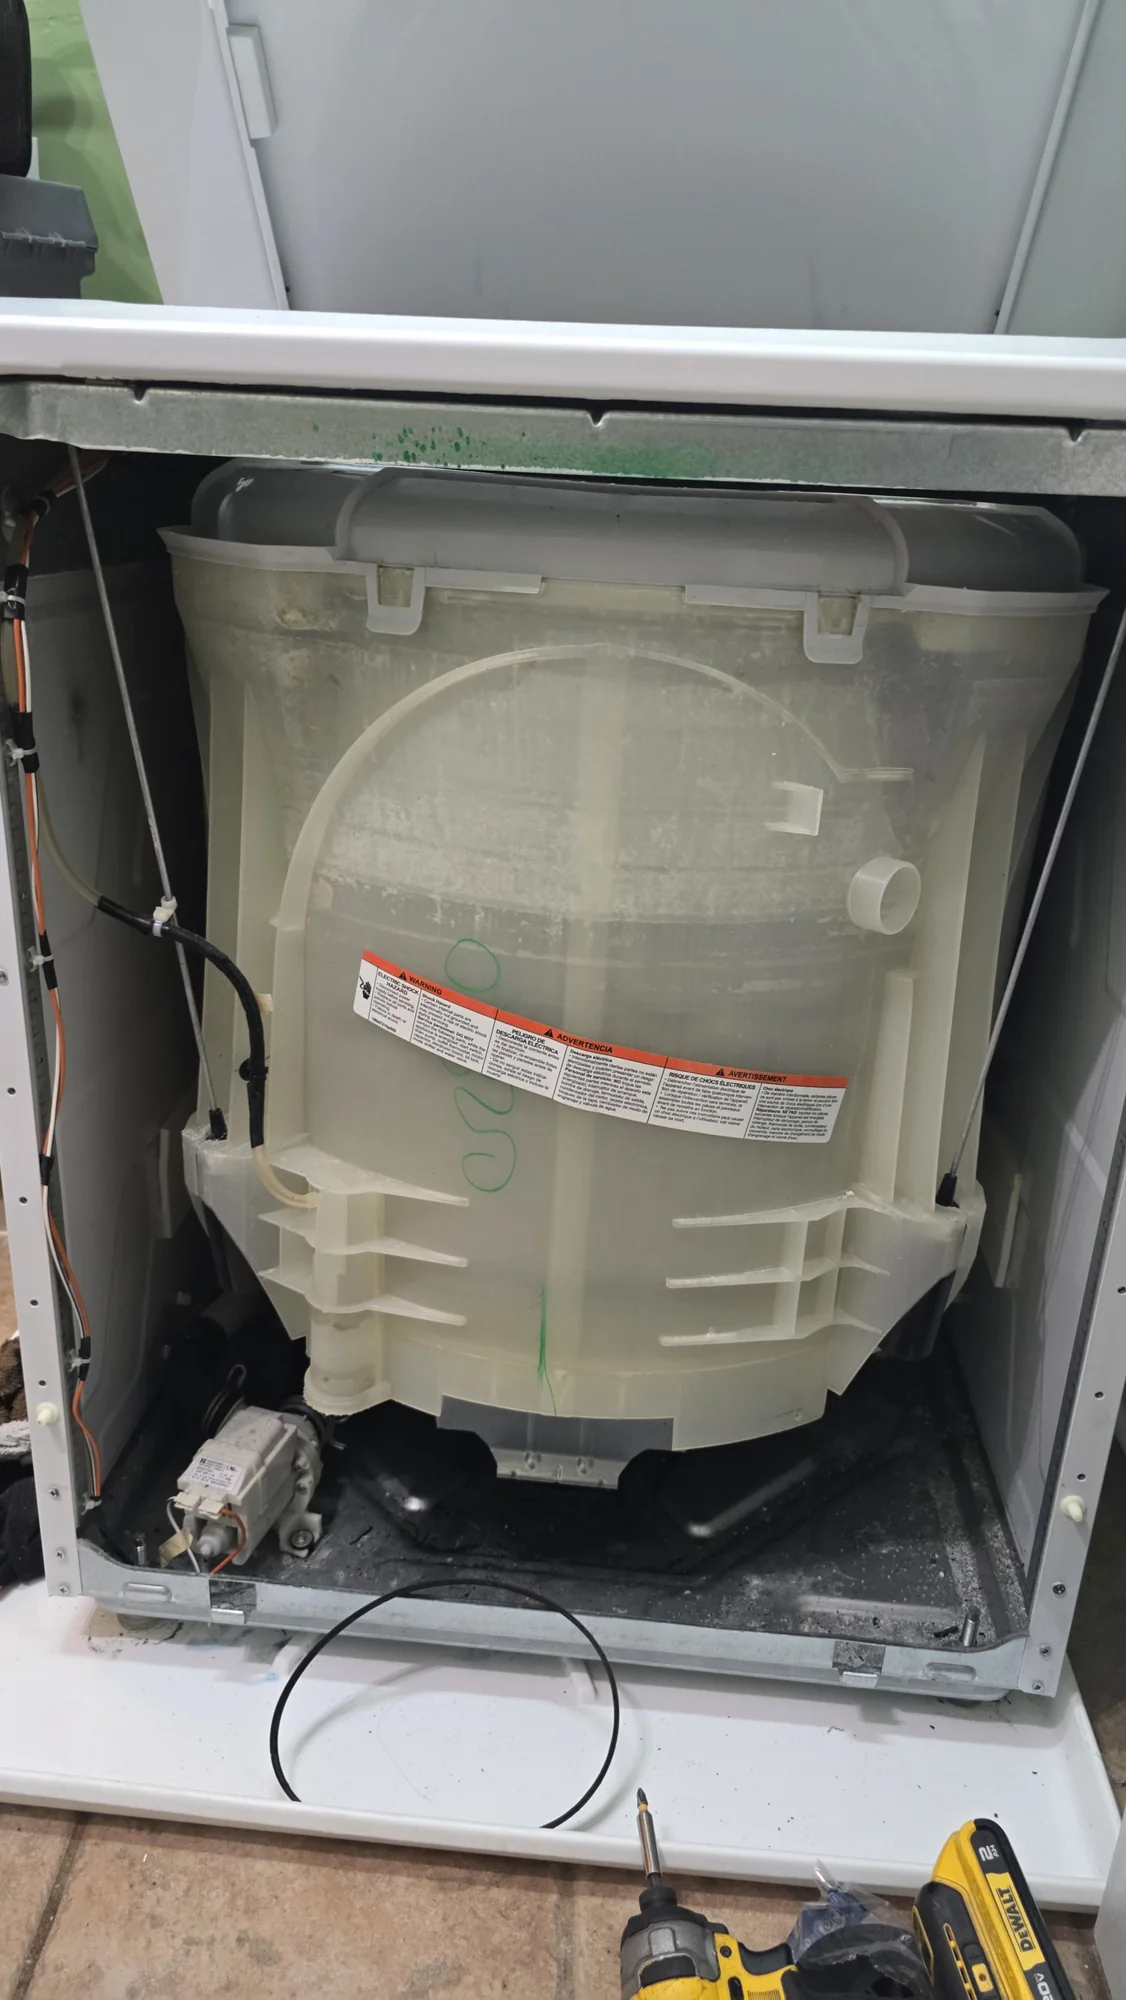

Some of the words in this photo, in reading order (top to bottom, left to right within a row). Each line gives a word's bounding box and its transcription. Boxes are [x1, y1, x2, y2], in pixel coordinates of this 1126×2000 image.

[378, 971, 401, 986] ELECTRIC
[401, 983, 419, 995] SHOCK
[386, 981, 408, 995] HAZARD
[409, 975, 443, 995] WARNING
[496, 1029, 527, 1044] DESCARGA
[512, 1028, 537, 1042] PELIGRO
[557, 1034, 613, 1054] ADVERTENCIA
[668, 1072, 690, 1080] RISQUE
[699, 1077, 719, 1085] CHOCS
[728, 1070, 788, 1083] AVERTISSEMENT
[978, 1845, 994, 1862] 2
[996, 1887, 1035, 1953] DEWALT
